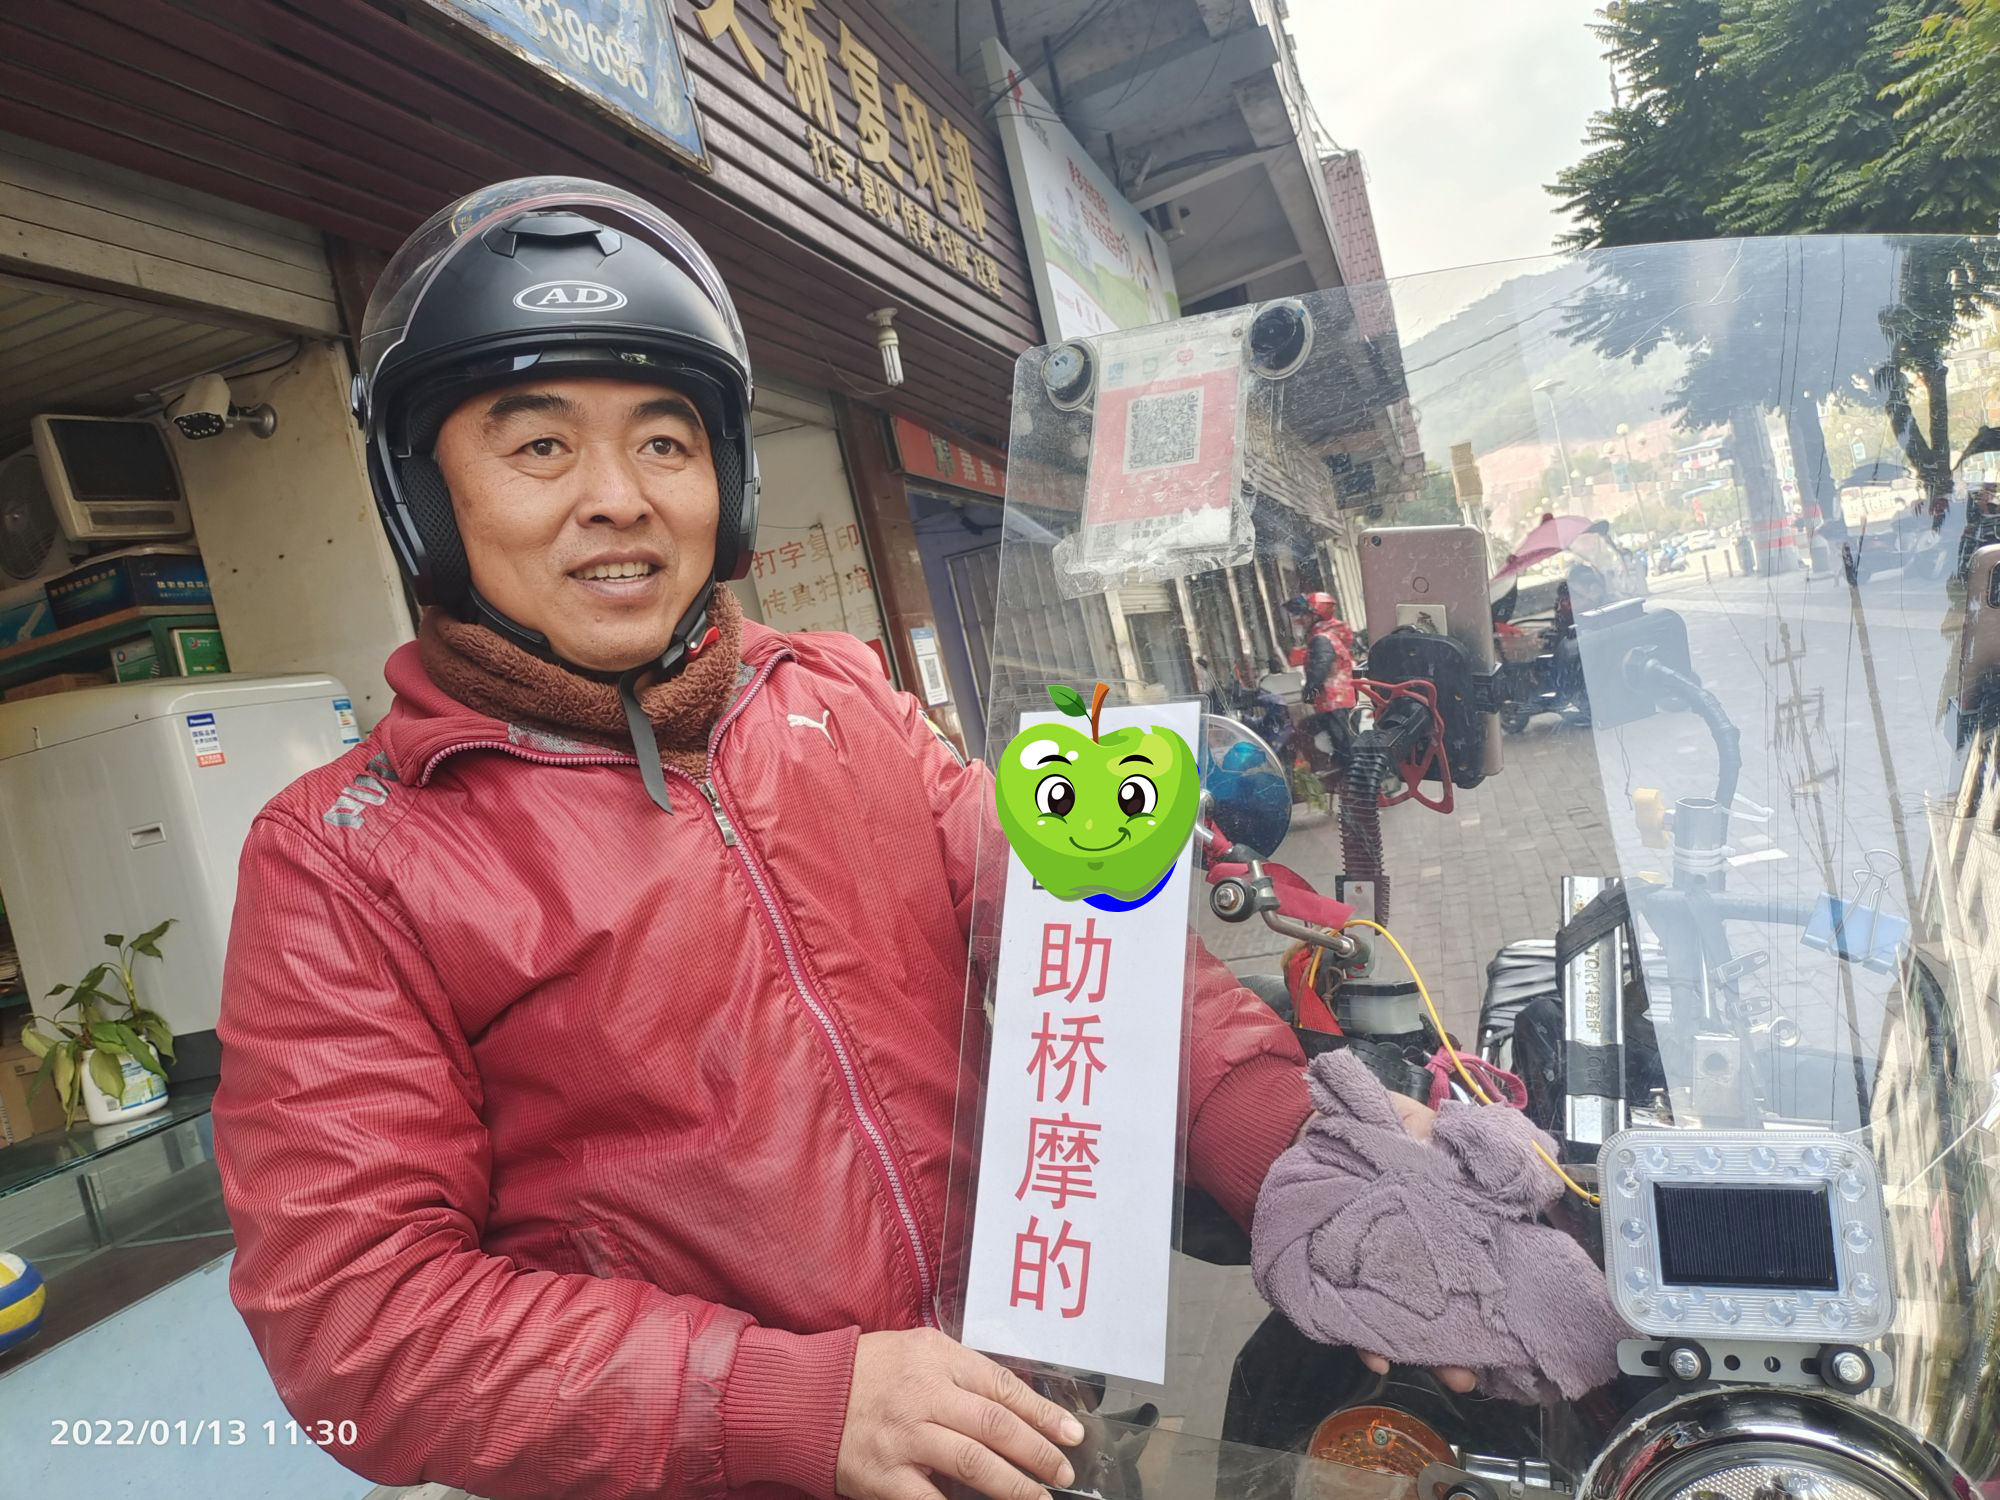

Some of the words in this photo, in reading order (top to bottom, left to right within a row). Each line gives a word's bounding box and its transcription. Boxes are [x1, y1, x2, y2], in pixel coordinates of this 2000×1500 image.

[804, 124, 854, 200] 打字
[854, 157, 898, 228] 复印
[897, 192, 936, 257] 传真
[536, 287, 608, 306] AD
[753, 523, 860, 579] 打字复印
[1008, 917, 1114, 1320] 助桥摩的
